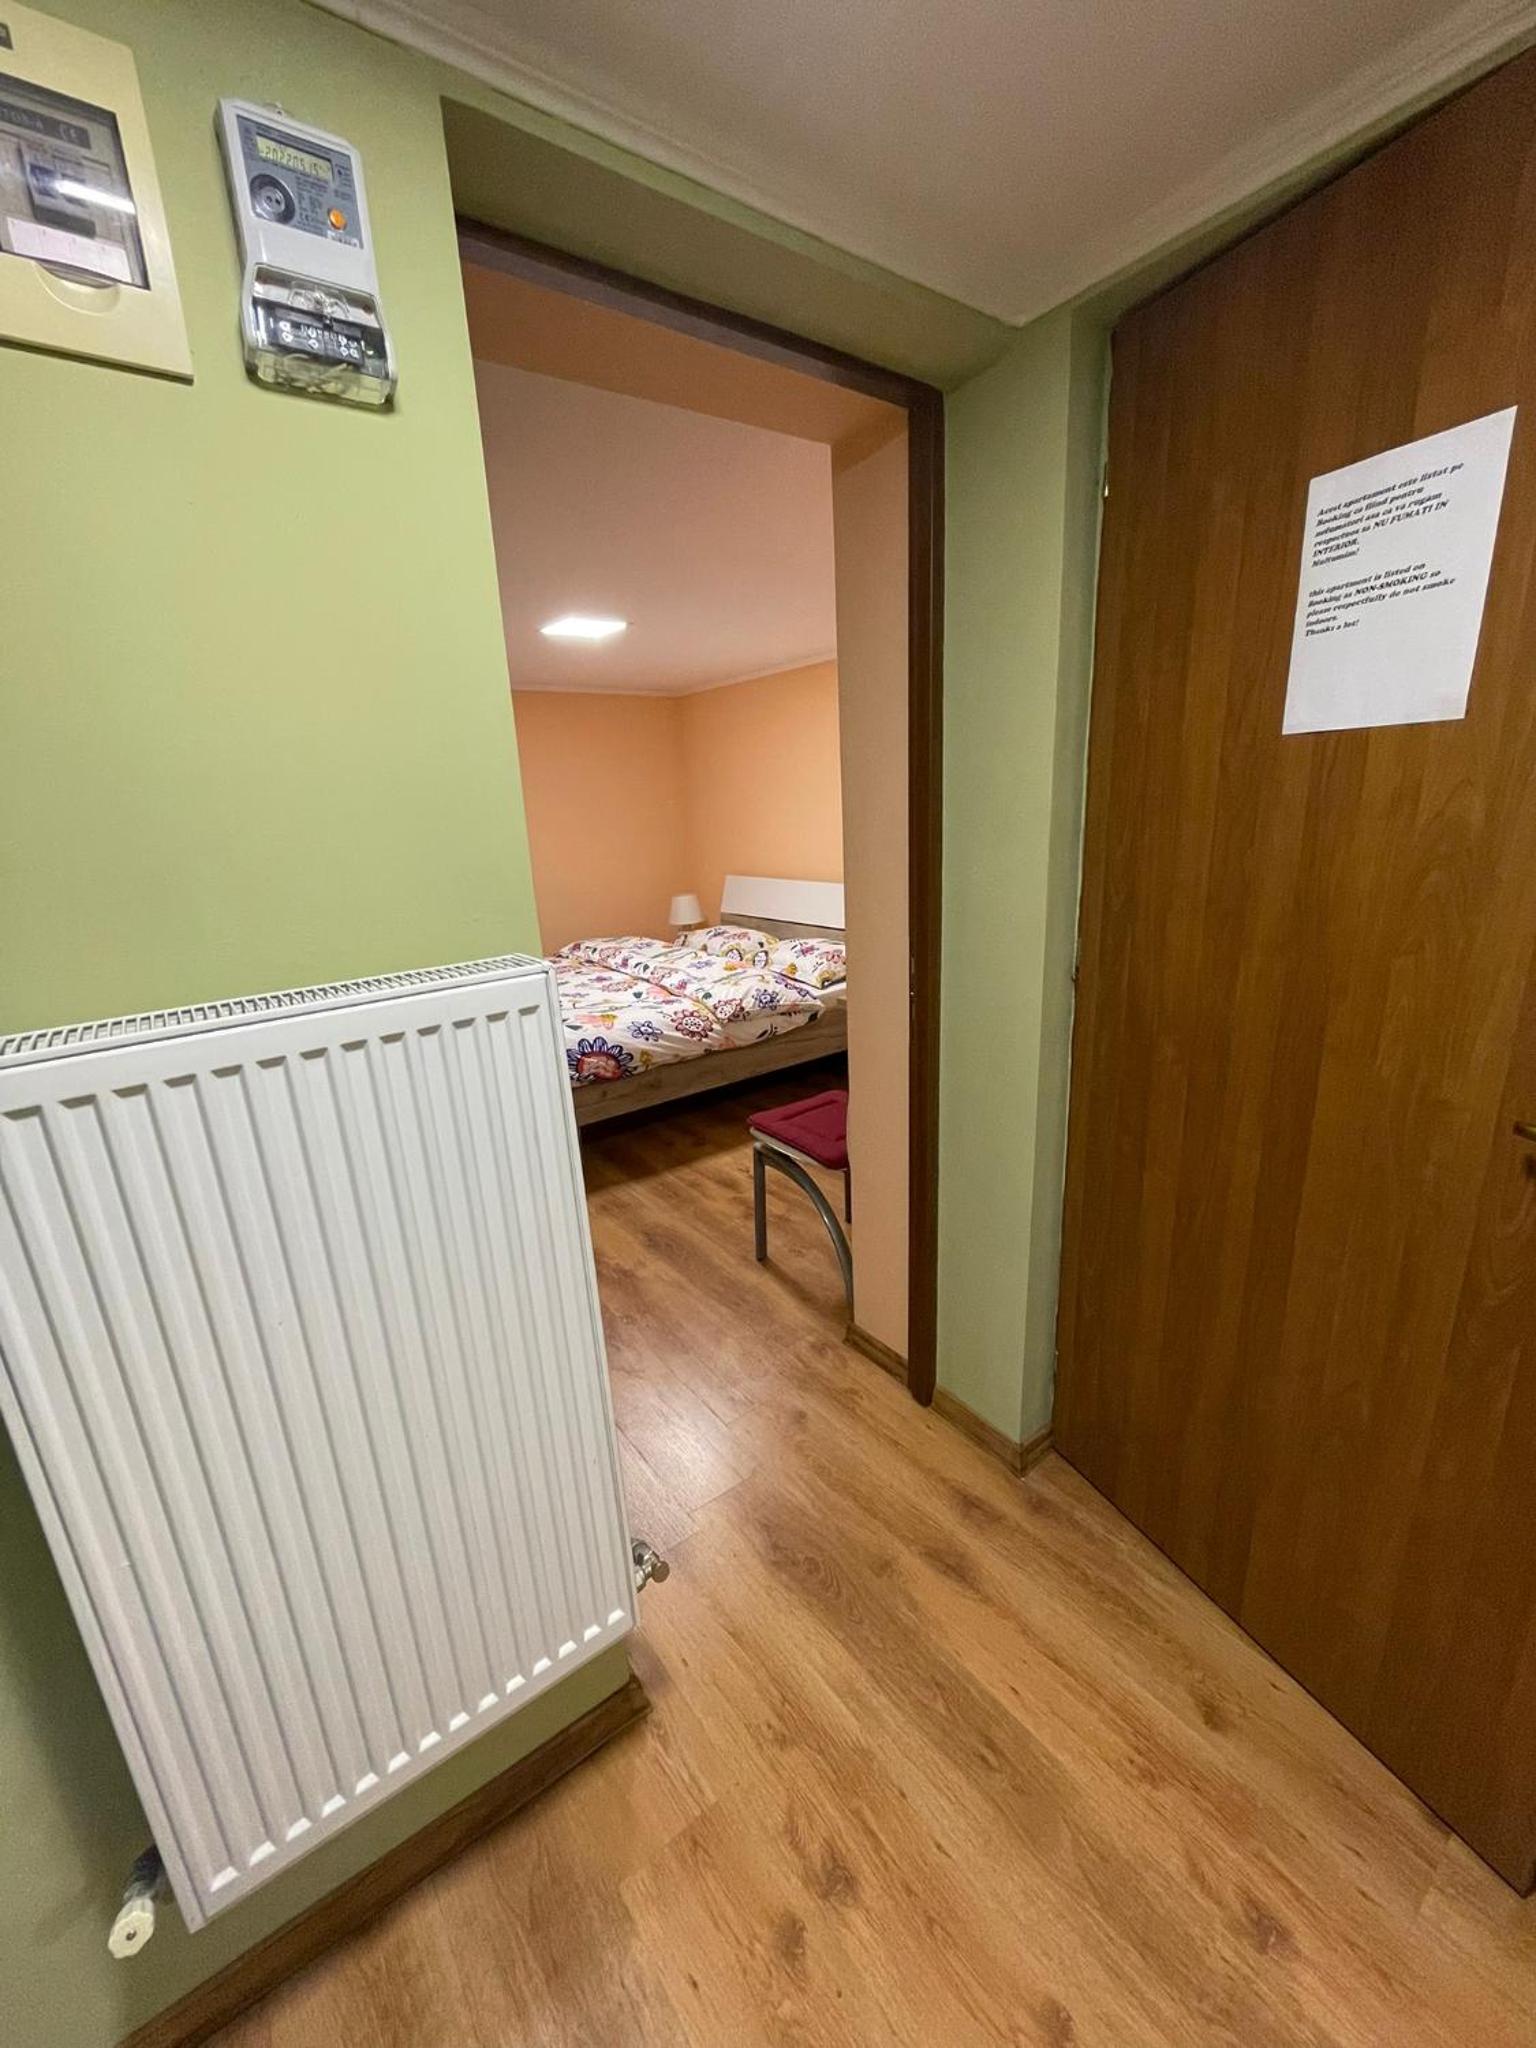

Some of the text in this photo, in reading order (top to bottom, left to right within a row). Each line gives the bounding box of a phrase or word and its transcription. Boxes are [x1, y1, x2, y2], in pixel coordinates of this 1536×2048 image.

[1315, 510, 1352, 527] Booking
[1389, 486, 1424, 504] pentru
[1317, 462, 1464, 517] Acest apartament este listat pe
[1314, 514, 1365, 538] nefumatori
[1365, 511, 1380, 521] asa
[1395, 503, 1406, 511] va
[1373, 517, 1389, 530] NU
[1389, 504, 1433, 525] FUMATI
[1434, 499, 1450, 511] IN
[1312, 537, 1360, 558] INTERIOR.
[1308, 570, 1441, 608] Booking as NON-SMOKING so
[1325, 575, 1372, 594] apartment
[1374, 572, 1382, 581] is
[1384, 564, 1411, 579] listed
[1412, 562, 1426, 571] on
[1306, 577, 1456, 619] please respectfully do not smoke
[1342, 618, 1360, 629] lot!
